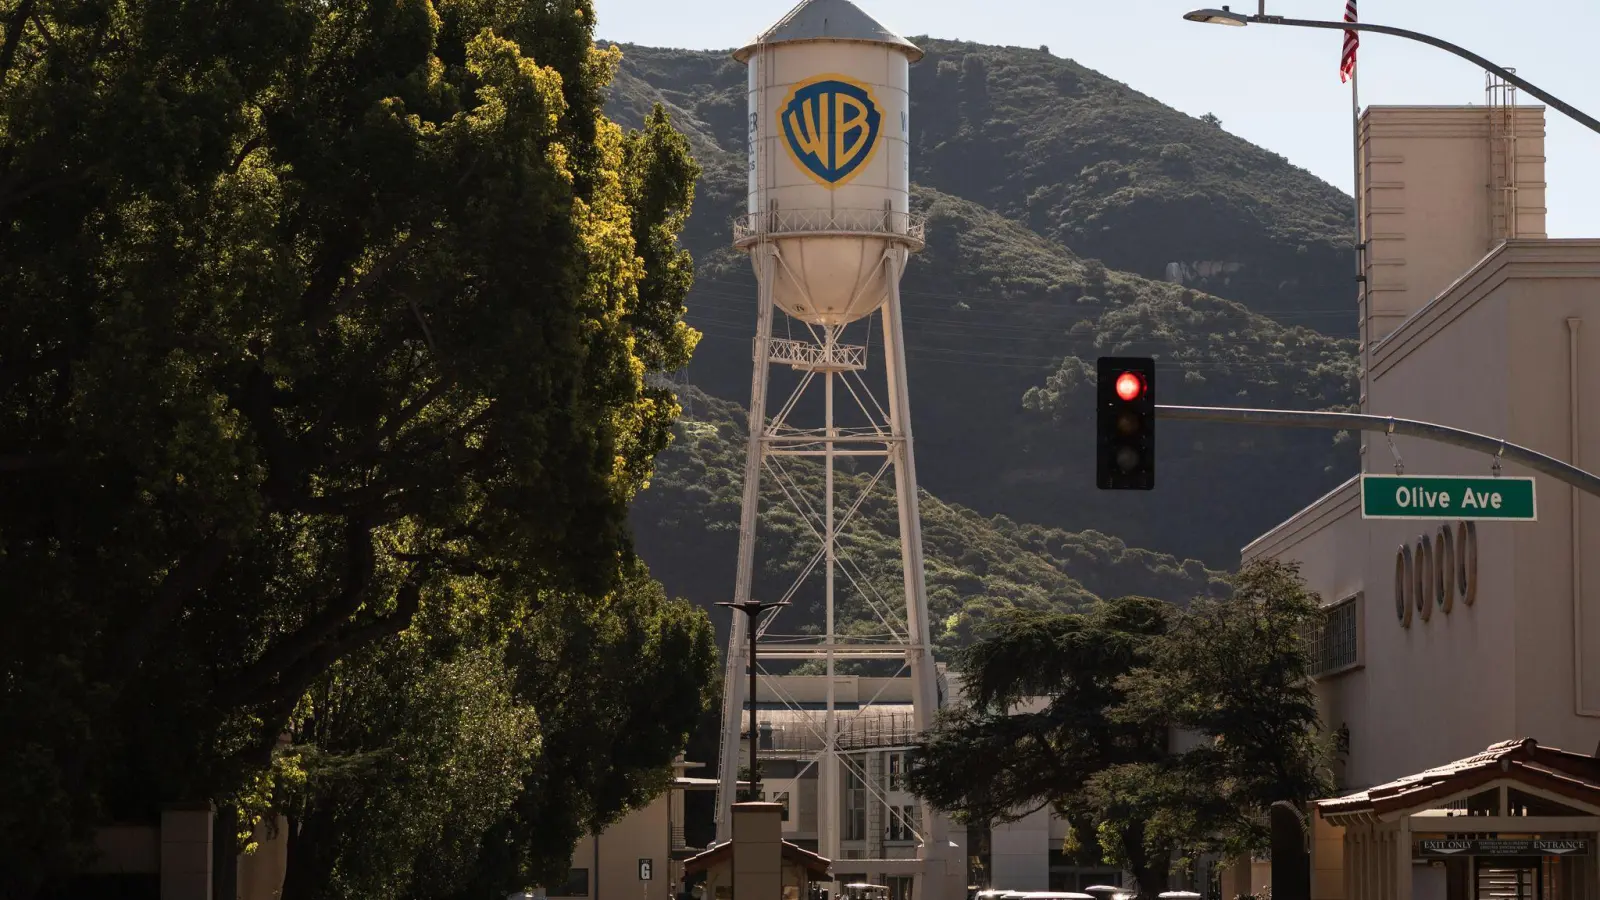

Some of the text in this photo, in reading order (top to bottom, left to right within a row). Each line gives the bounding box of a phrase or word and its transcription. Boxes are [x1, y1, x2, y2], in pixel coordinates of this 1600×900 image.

[788, 92, 870, 170] WB
[1395, 485, 1503, 509] Olive Ave
[1424, 841, 1446, 849] EXIT
[1448, 841, 1473, 849] ONLY
[1533, 841, 1585, 849] ENTRANCE
[641, 863, 650, 879] G
